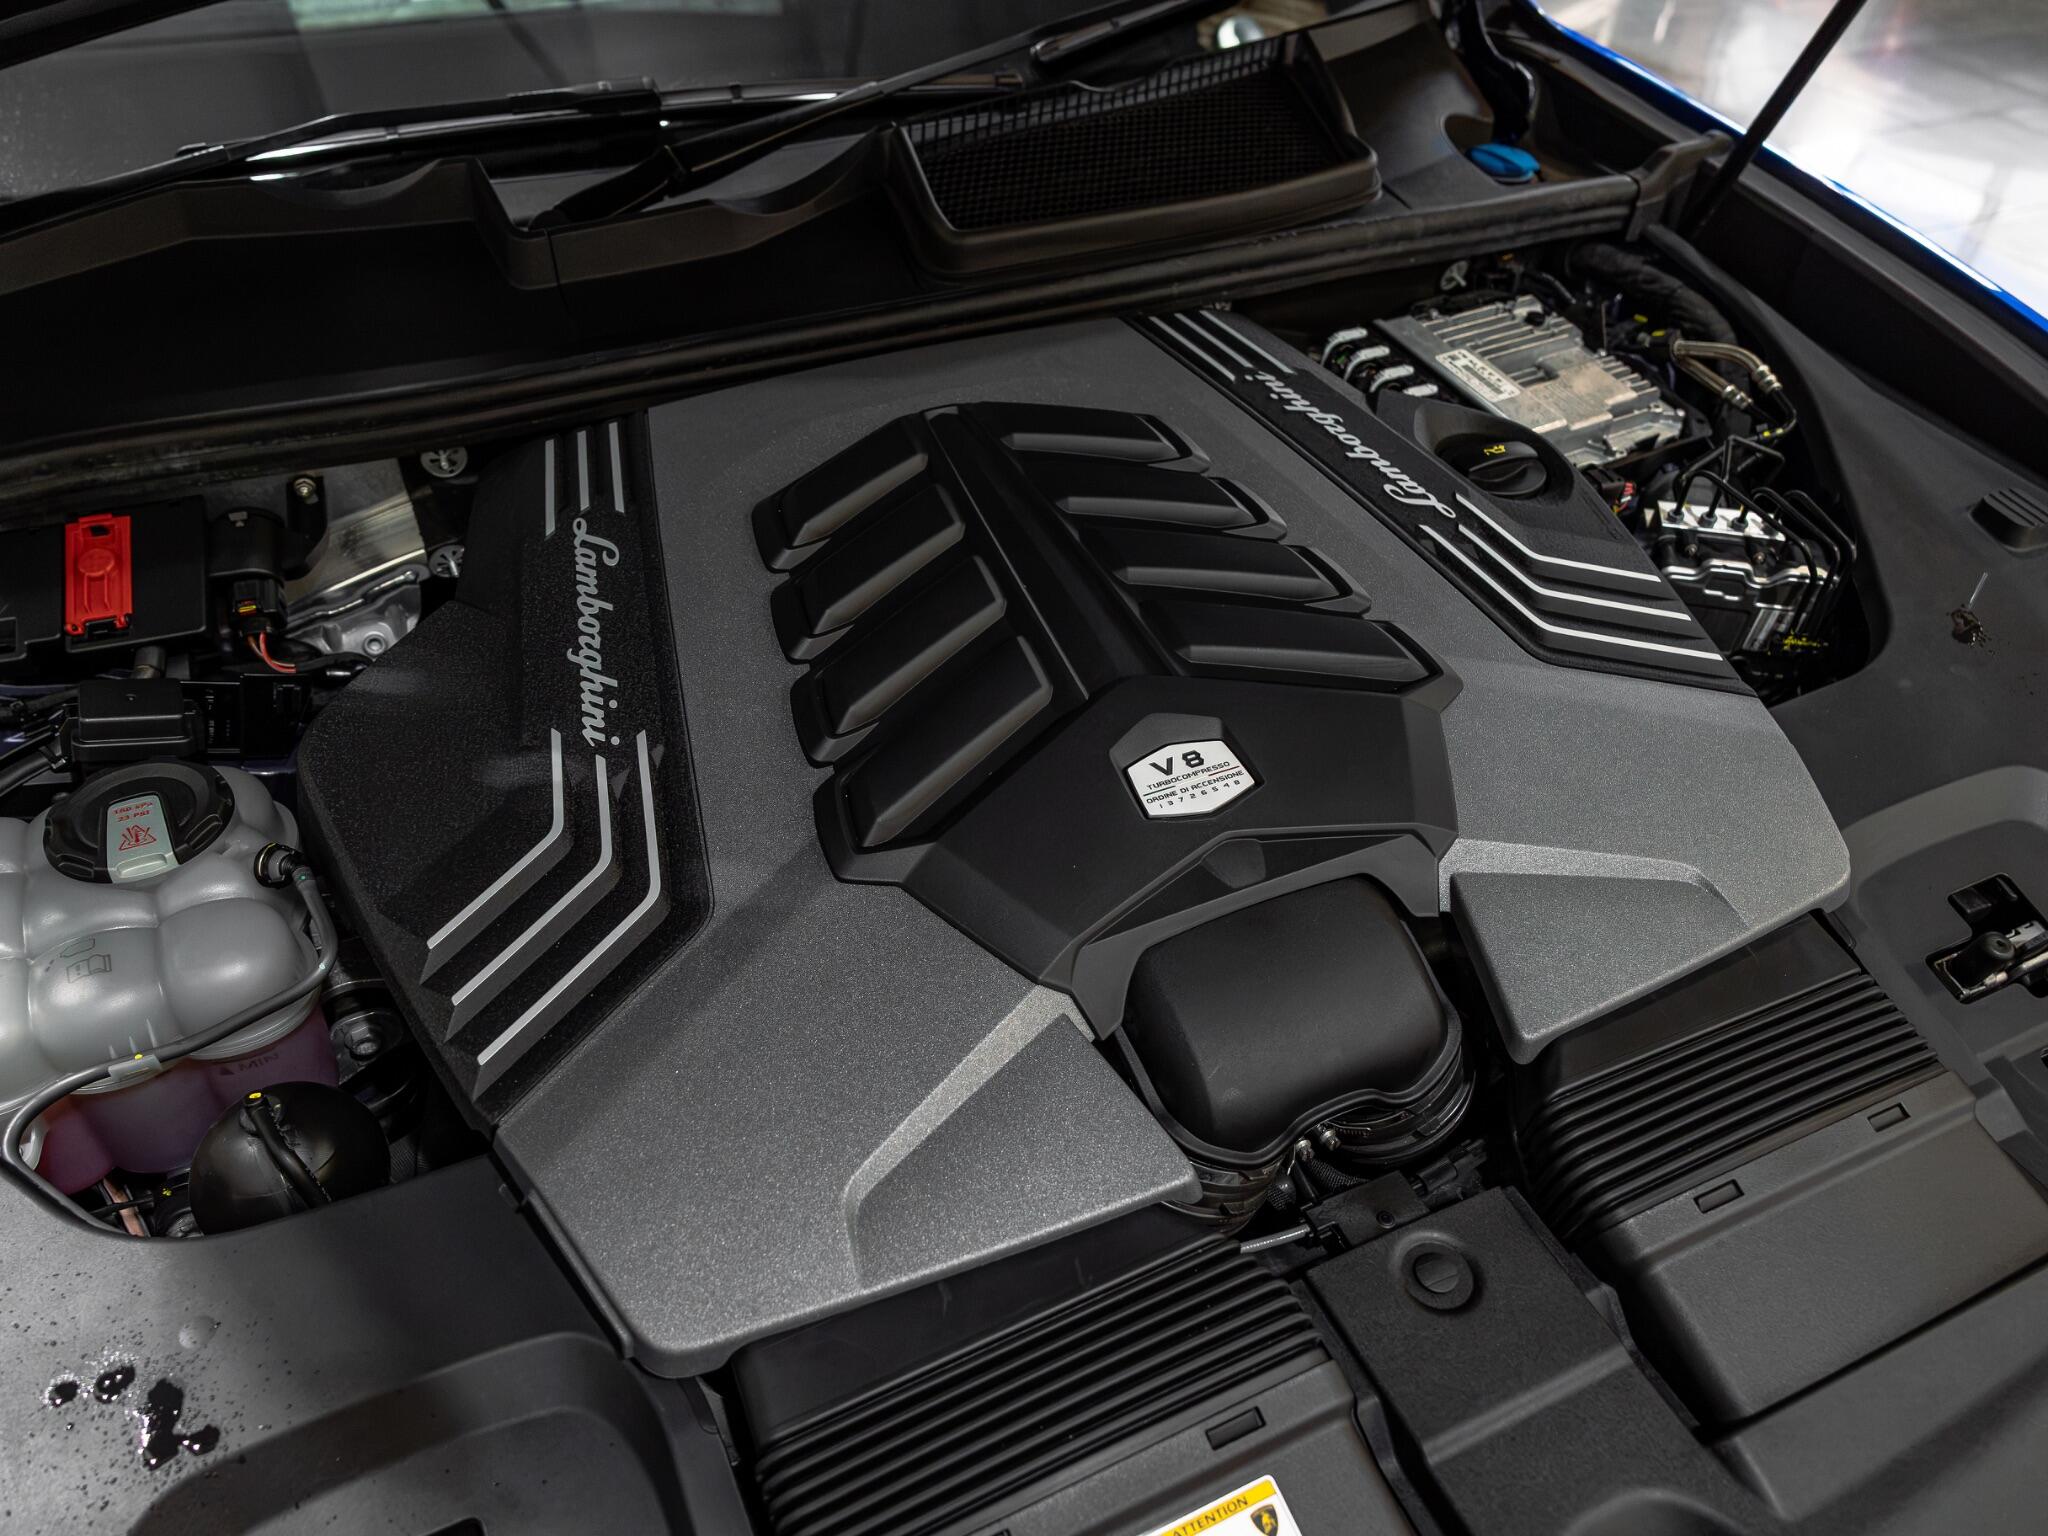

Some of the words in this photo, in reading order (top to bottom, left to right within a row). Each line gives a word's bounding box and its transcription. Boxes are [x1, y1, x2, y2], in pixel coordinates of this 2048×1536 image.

[1244, 370, 1457, 519] Lamborghini
[566, 517, 620, 747] Lamborghini
[1146, 761, 1231, 790] TURBOCOMPRESSO
[1146, 790, 1178, 804] ORDINE
[1180, 786, 1190, 794] DI
[1191, 769, 1245, 790] ACCENSIONE
[238, 1052, 279, 1071] MIN
[1173, 1496, 1249, 1536] ATTENTION
